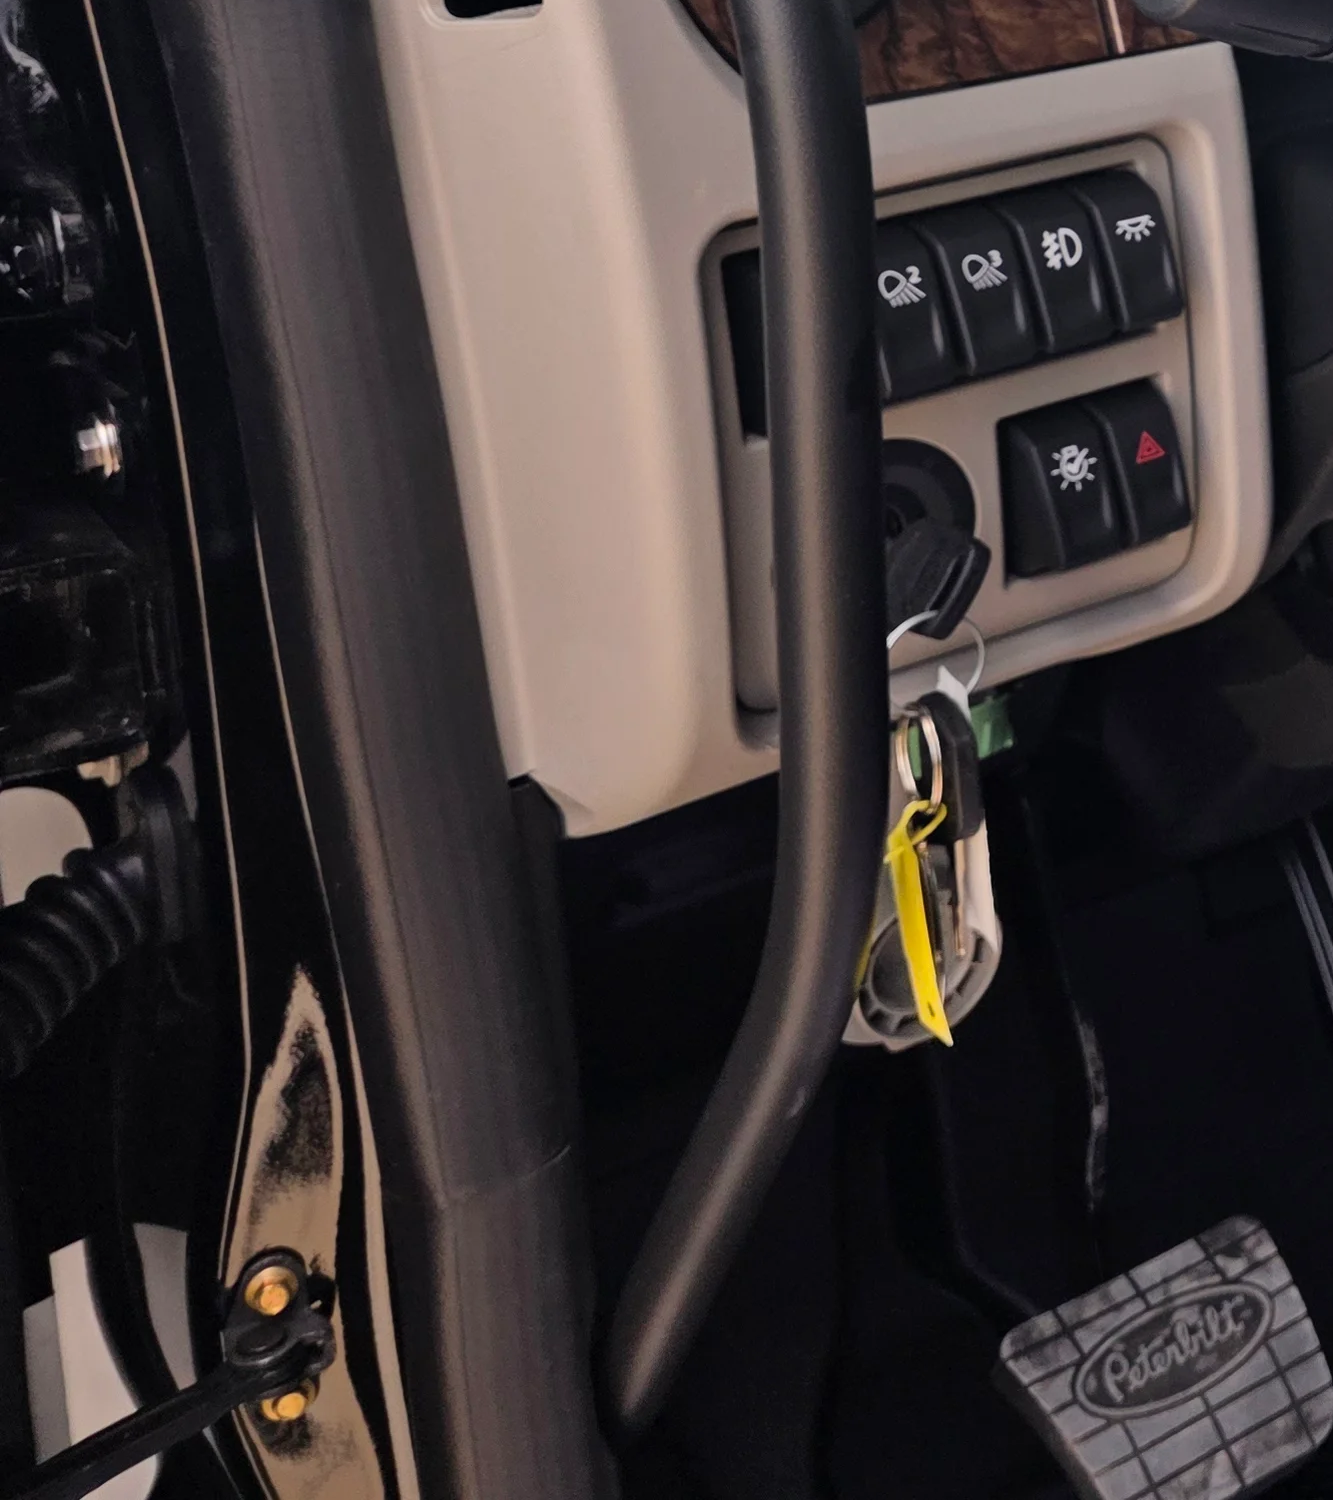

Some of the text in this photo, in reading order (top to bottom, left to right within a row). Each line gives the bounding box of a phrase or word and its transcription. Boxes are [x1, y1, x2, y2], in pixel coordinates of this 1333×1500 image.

[986, 249, 1003, 268] 3
[906, 265, 923, 284] 2
[1100, 1294, 1254, 1402] Peterbilt
